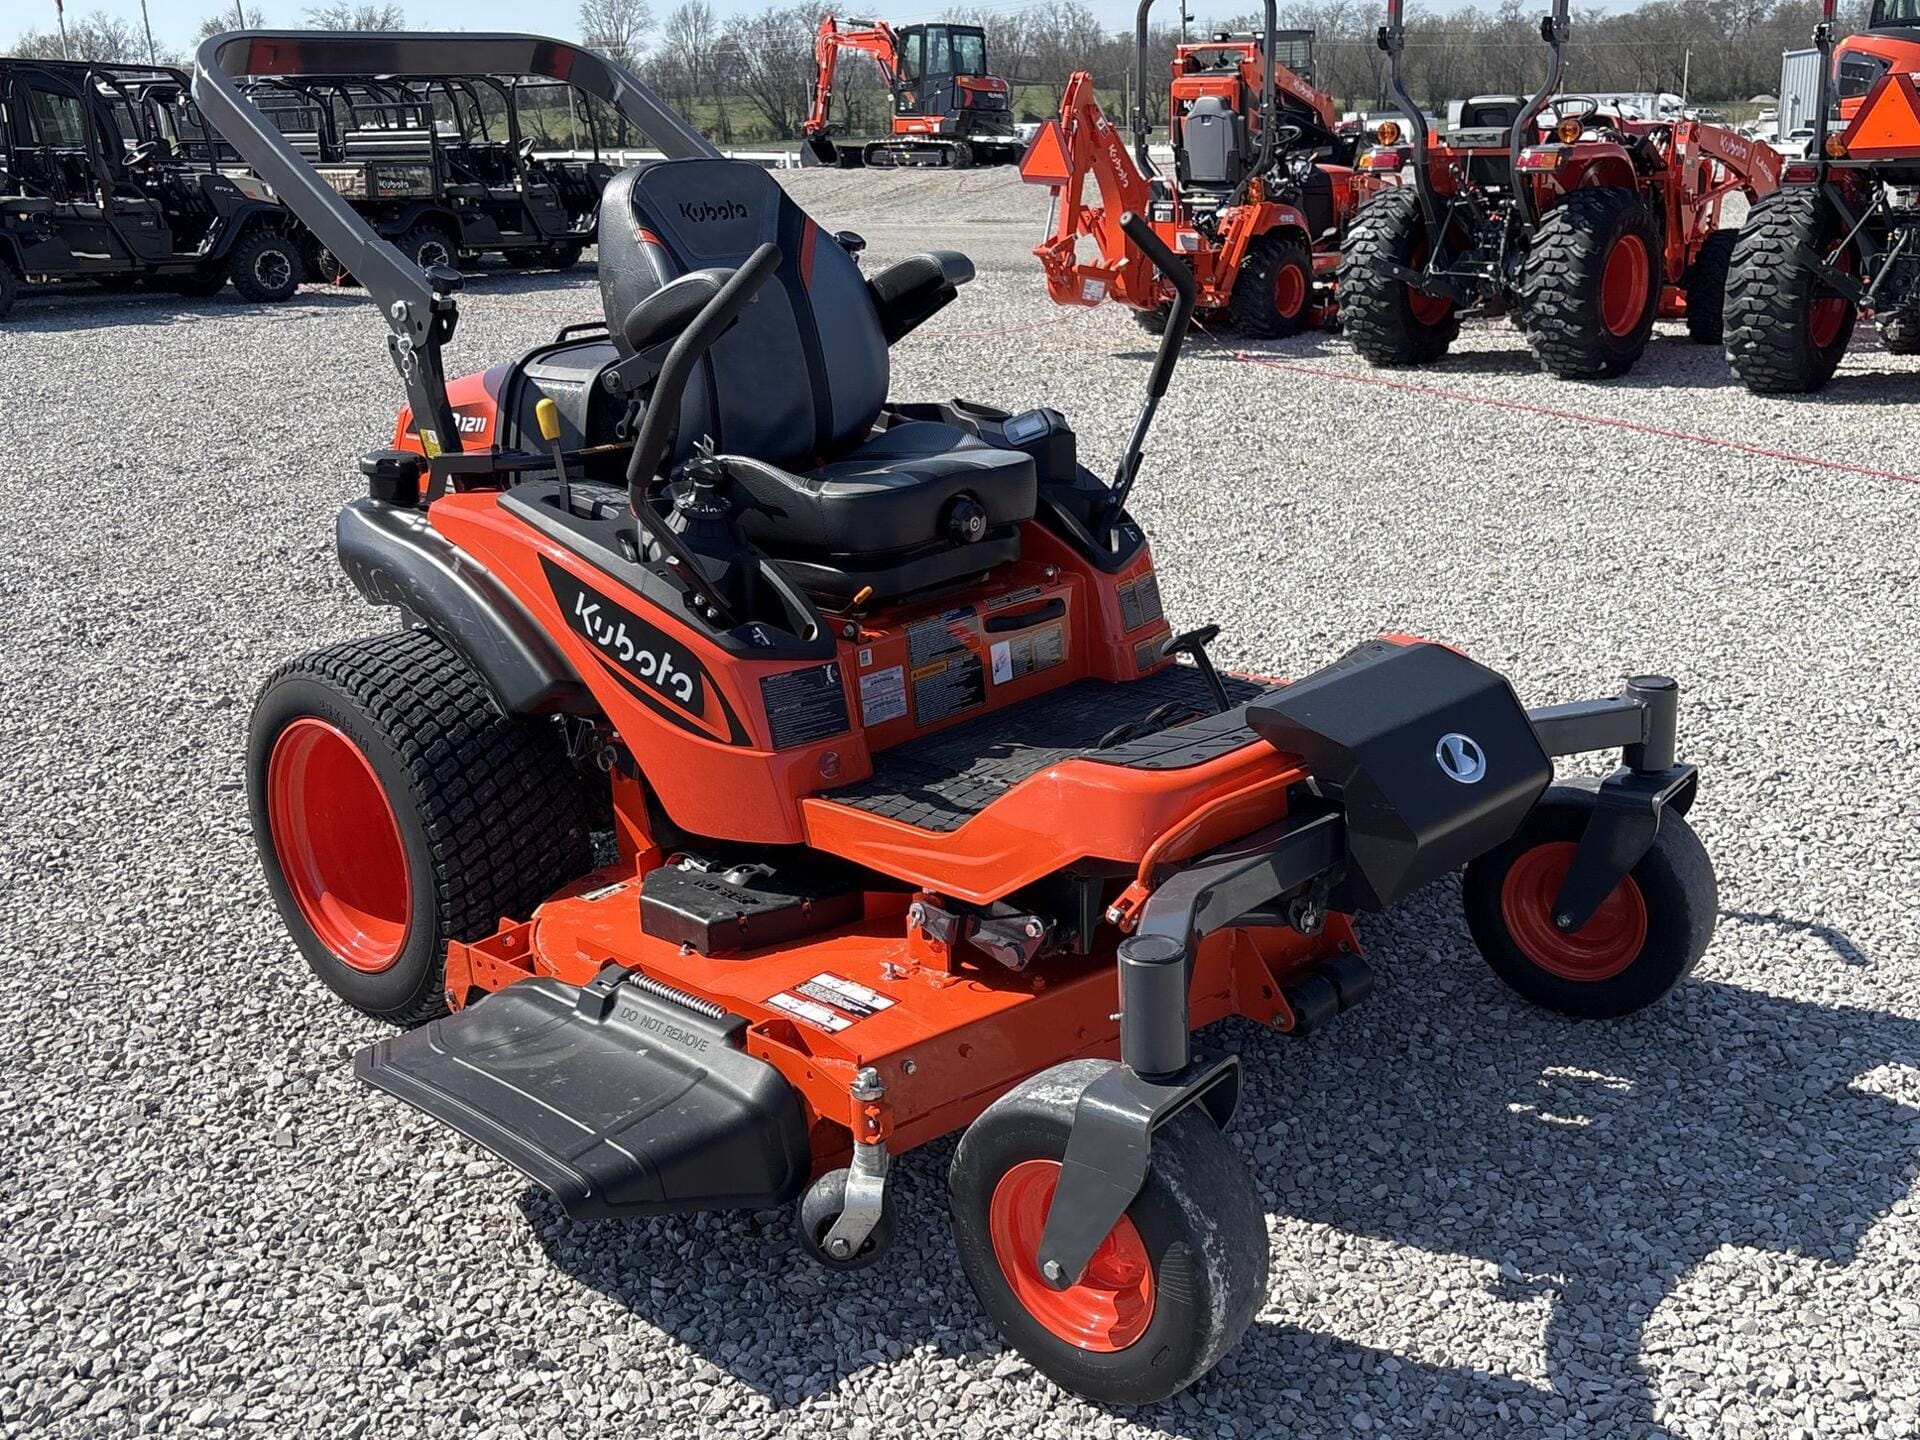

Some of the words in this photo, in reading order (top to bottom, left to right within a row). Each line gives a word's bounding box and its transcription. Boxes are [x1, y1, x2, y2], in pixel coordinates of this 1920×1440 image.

[1720, 135, 1747, 159] Kubota
[1108, 144, 1129, 188] Kubota
[379, 181, 410, 189] Kubota
[678, 200, 748, 222] Kubota
[575, 591, 693, 702] Kubota
[621, 1007, 638, 1022] DO
[640, 1015, 664, 1032] NOT
[663, 1025, 709, 1052] REMOVE
